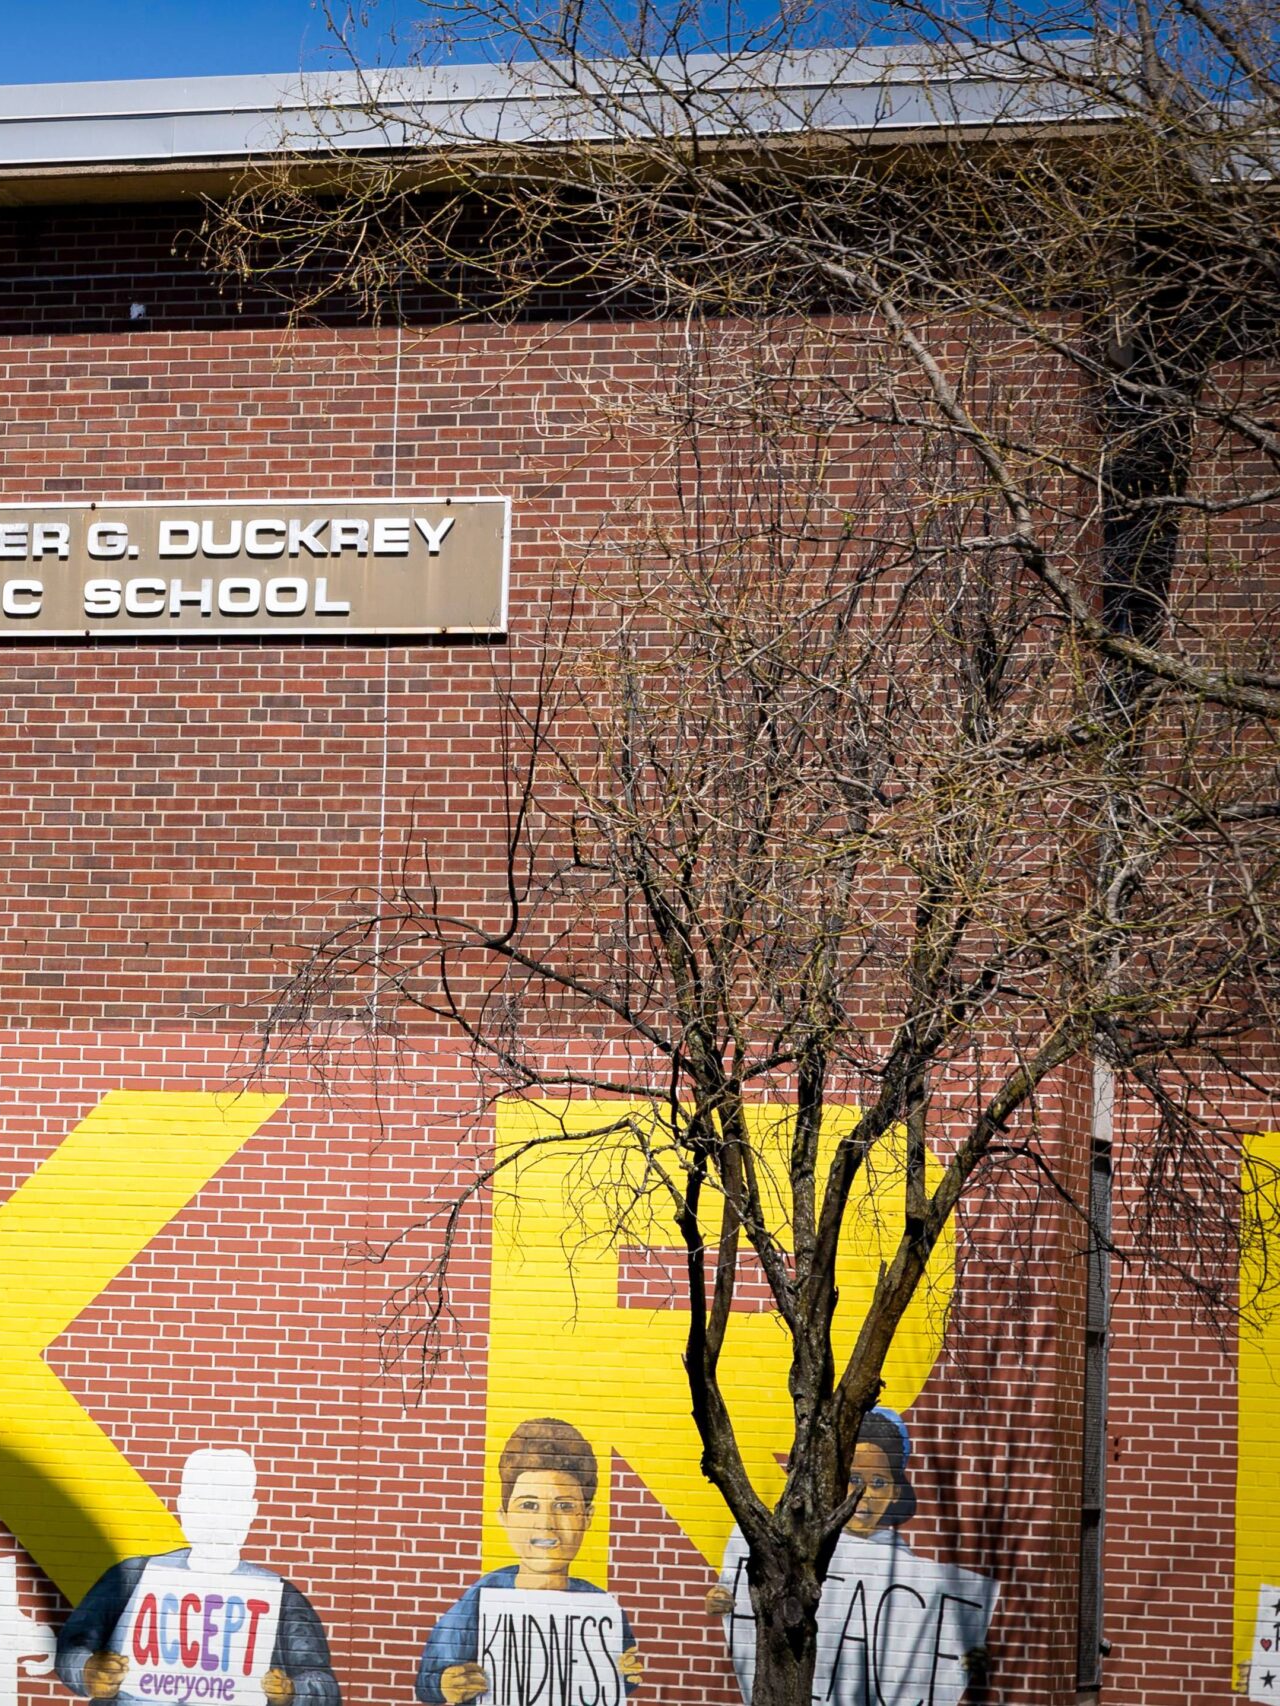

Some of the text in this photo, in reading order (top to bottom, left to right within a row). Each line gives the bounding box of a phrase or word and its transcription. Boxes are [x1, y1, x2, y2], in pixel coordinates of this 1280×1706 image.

[86, 522, 139, 557] G.
[158, 518, 456, 557] DUCKREY
[83, 577, 351, 615] SCHOOL
[132, 1592, 270, 1676] ACCEPT
[479, 1613, 621, 1706] KINDNESS
[139, 1673, 235, 1704] everyone
